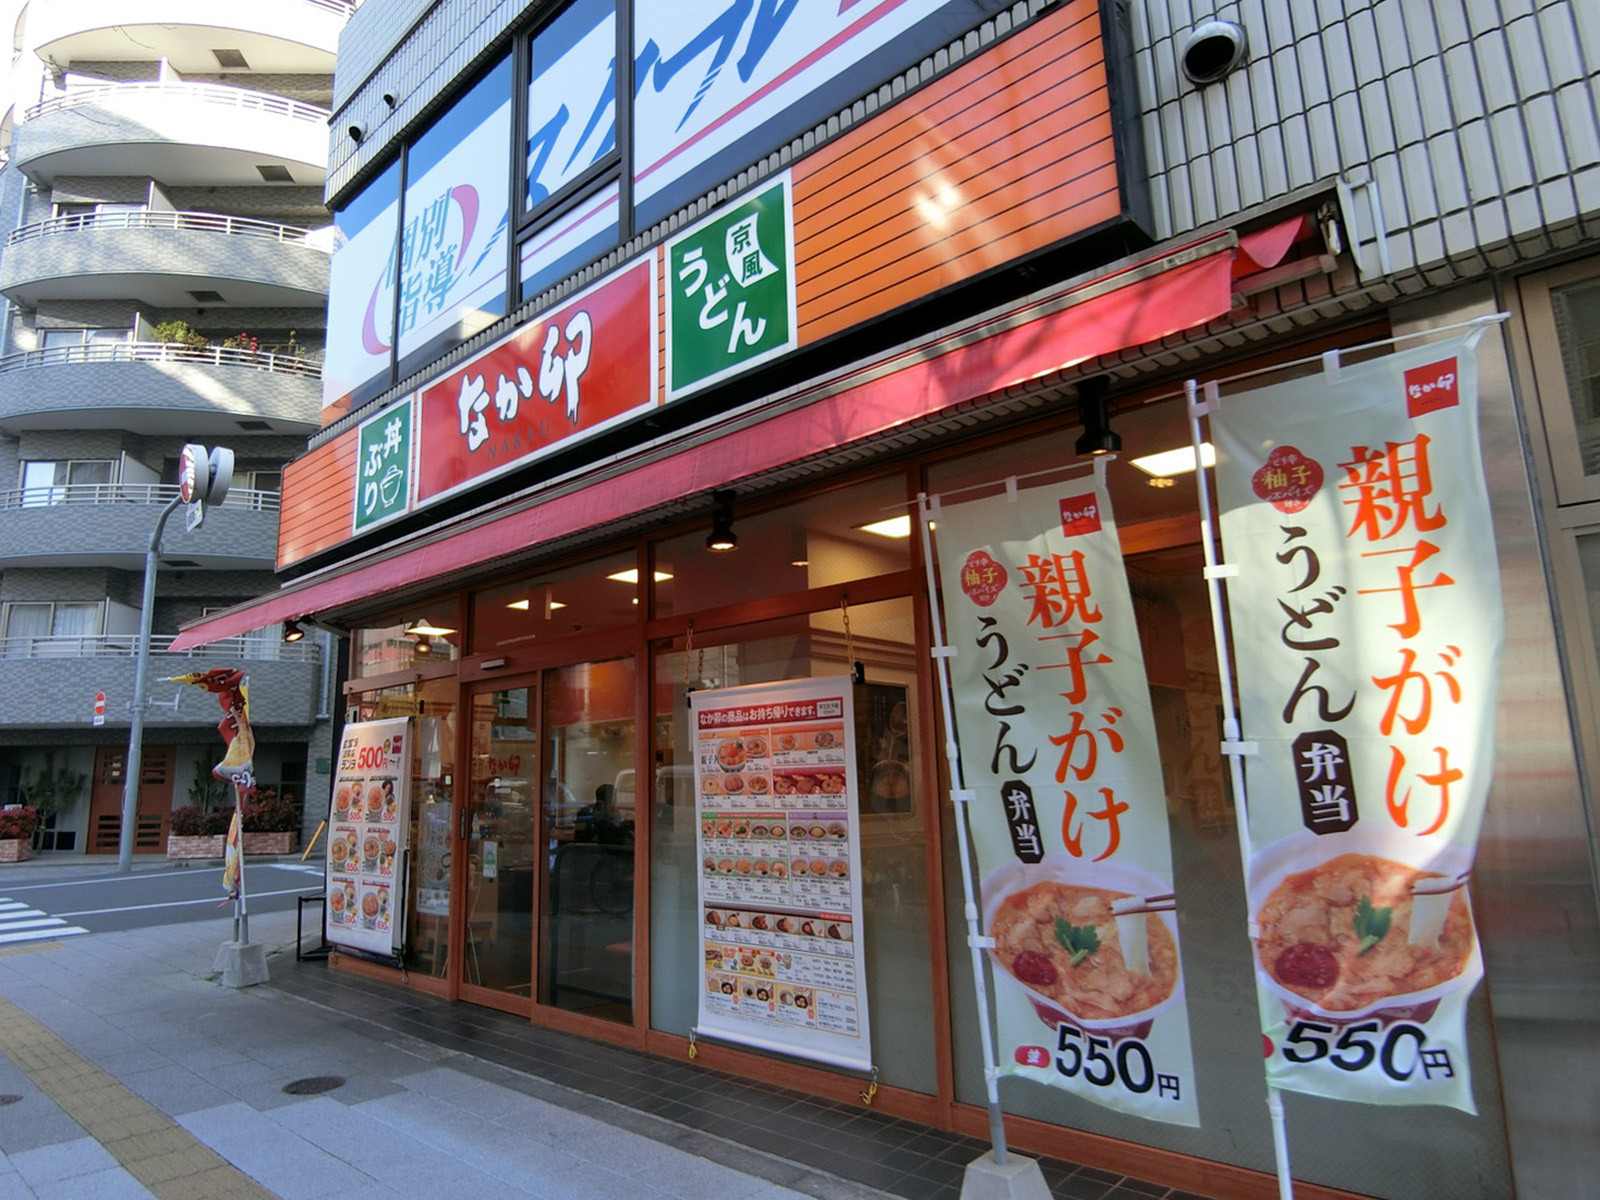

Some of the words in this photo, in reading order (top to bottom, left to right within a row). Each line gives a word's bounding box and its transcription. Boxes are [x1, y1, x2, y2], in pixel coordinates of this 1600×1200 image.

[679, 245, 767, 354] うどん
[731, 221, 763, 283] 京風
[458, 310, 593, 455] なか卯
[1276, 525, 1357, 723] うどん
[1337, 432, 1463, 836] 親子がけ
[976, 615, 1038, 775] うどん
[1016, 549, 1129, 862] 親子がけ
[1008, 788, 1040, 858] 弁当
[1301, 742, 1349, 823] 弁当
[1055, 1023, 1180, 1100] 550円
[1281, 1020, 1454, 1082] 550円
